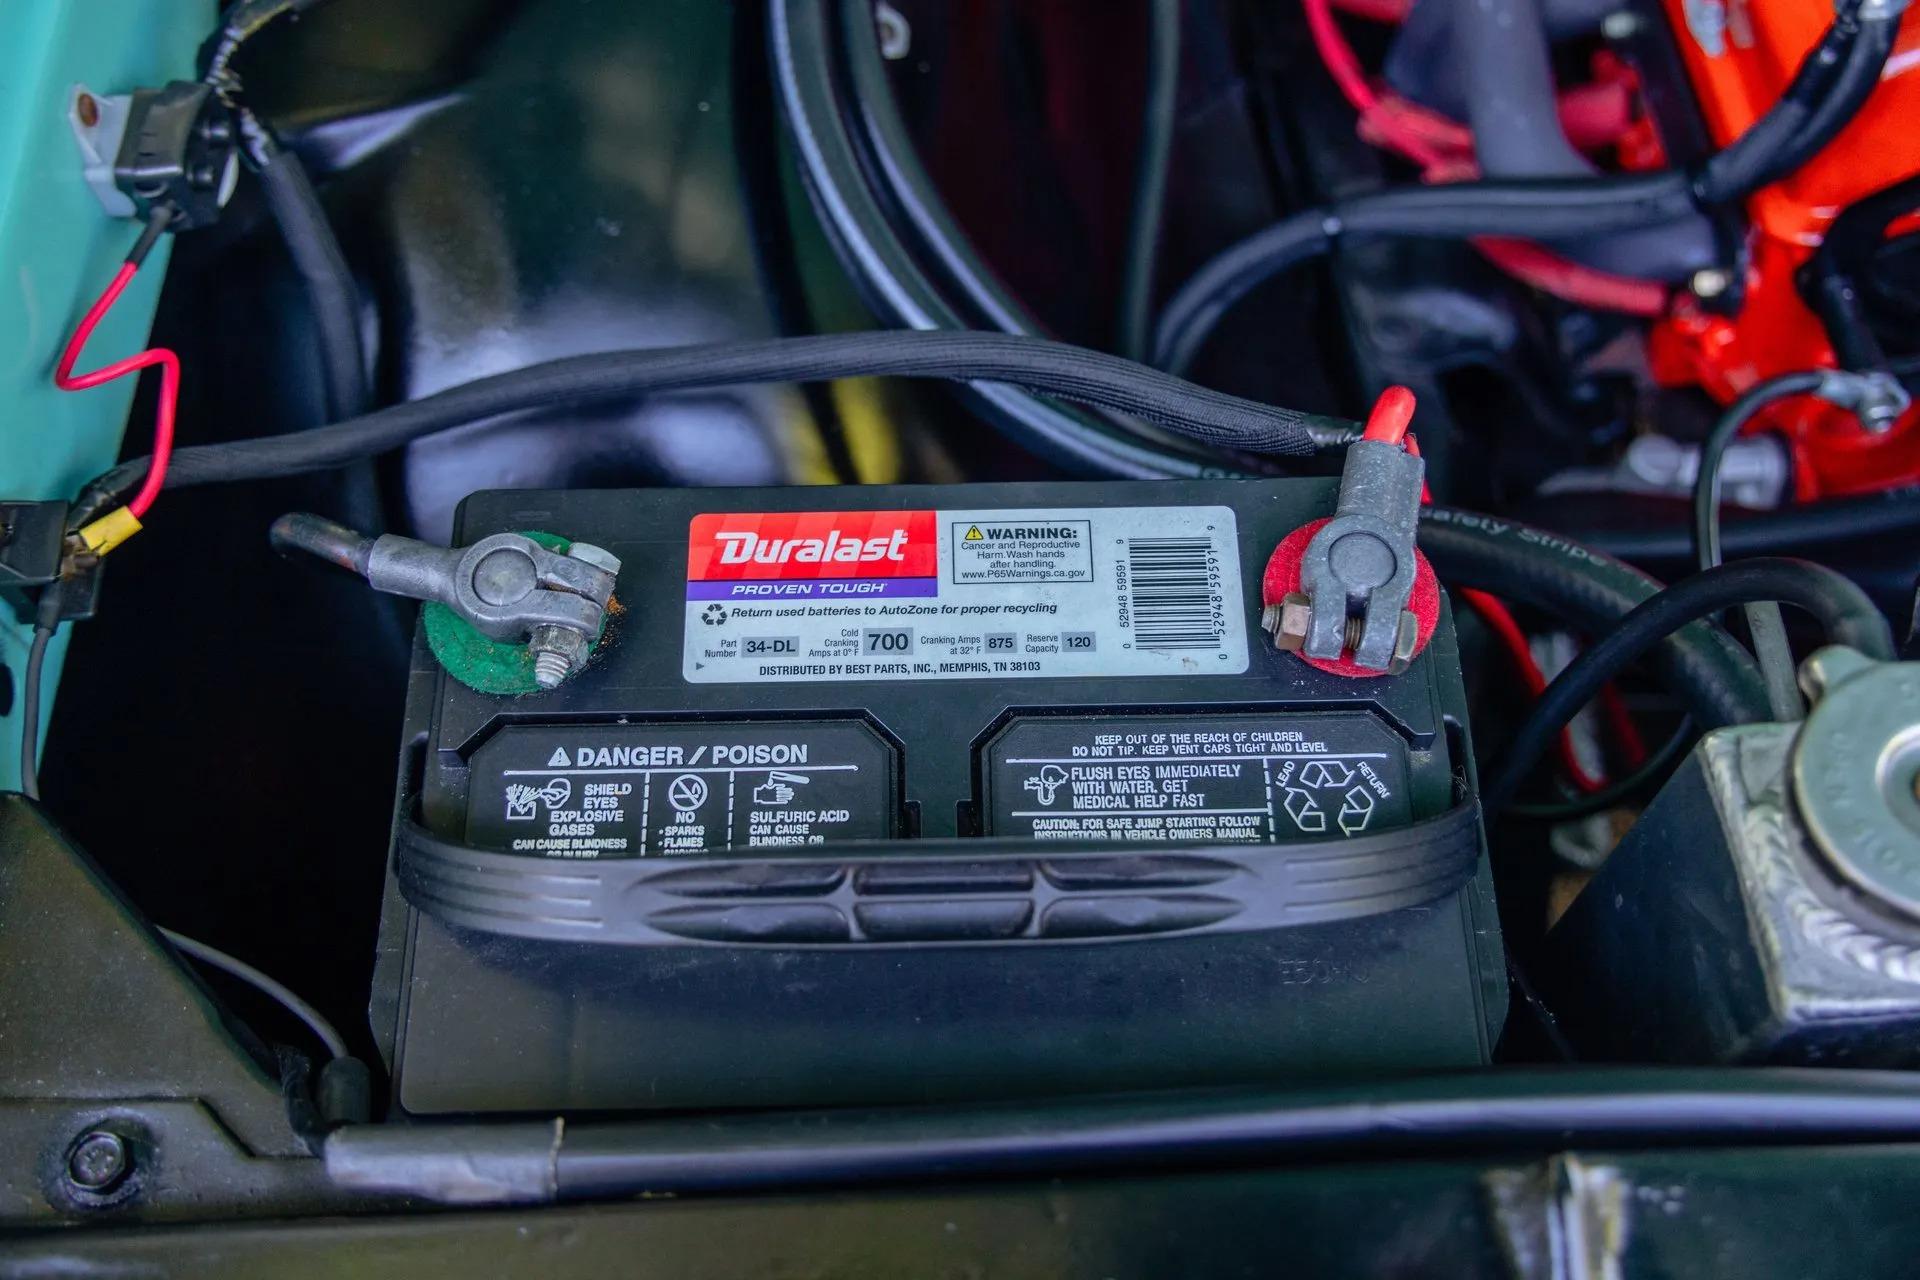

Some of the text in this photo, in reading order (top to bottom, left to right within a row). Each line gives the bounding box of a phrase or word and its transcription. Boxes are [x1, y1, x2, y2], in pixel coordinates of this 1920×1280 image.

[987, 528, 1077, 540] WARNING:
[715, 529, 908, 564] Duralast
[961, 540, 1080, 550] Cancer and Reproductive
[1035, 550, 1065, 558] hands
[990, 560, 1056, 569] after handling.
[1207, 551, 1221, 588] 59591
[962, 569, 1085, 579] www.P65Warnings.ca.gov
[1116, 560, 1126, 590] 59591
[732, 583, 885, 595] PROVEN TOUGH
[731, 603, 1057, 618] Return used batteries to AutoZone for proper recycling
[1118, 595, 1129, 627] 52948
[1212, 595, 1225, 635] 52948
[841, 629, 858, 637] Cold
[1027, 634, 1058, 642] Reserve
[824, 639, 858, 648] Cranking
[868, 633, 909, 651] 700
[921, 635, 980, 645] Cranking Amps
[988, 638, 1013, 648] 875
[1067, 637, 1090, 647] 120
[747, 640, 795, 653] 34-DL
[950, 647, 958, 655] at
[976, 646, 981, 654] F
[1025, 644, 1059, 654] Capacity
[705, 649, 736, 657] Number
[809, 649, 831, 658] Amps
[760, 665, 826, 675] DISTRIBUTED
[829, 665, 843, 675] BY
[846, 665, 871, 674] BEST
[874, 664, 910, 675] PARTS,
[940, 663, 991, 673] MEMPHIS,
[994, 663, 1007, 672] TN
[1009, 662, 1040, 672] 38103
[1095, 731, 1303, 745] KEEP OUT OF THE REACH OF CHILDREN
[577, 744, 808, 766] DANGER / POISON
[1072, 742, 1327, 757] DO NOT TIP. KEEP VENT CAPS TIGHT AND LEVEL
[1071, 764, 1240, 780] FLUSH EYES IMMEDIATELY
[1275, 761, 1294, 787] LEAD
[1357, 761, 1389, 798] RETURN
[584, 784, 631, 796] SHIELD
[1072, 781, 1105, 794] WITH
[1162, 780, 1189, 793] GET
[584, 797, 618, 808] EYES
[1073, 794, 1204, 808] MEDICAL HELP FAST
[550, 811, 623, 822] EXPLOSIVE
[675, 812, 695, 823] NO
[750, 810, 850, 823] SULFURIC ACID
[1033, 816, 1260, 830] CAUTION: FOR SAFE JUMP STARTING FOLLOW
[549, 824, 594, 836] GASES
[665, 826, 704, 836] SPARKS
[750, 824, 809, 835] CAN CAUSE
[1034, 831, 1107, 840] INSTRUCTIONS
[1111, 831, 1121, 840] IN
[1124, 830, 1166, 840] VEHICLE
[1169, 829, 1213, 839] OWNERS
[513, 839, 627, 849] CAN CAUSE BLINDNESS
[664, 837, 704, 848] FLAMES
[749, 835, 824, 846] BLINDNESS OR
